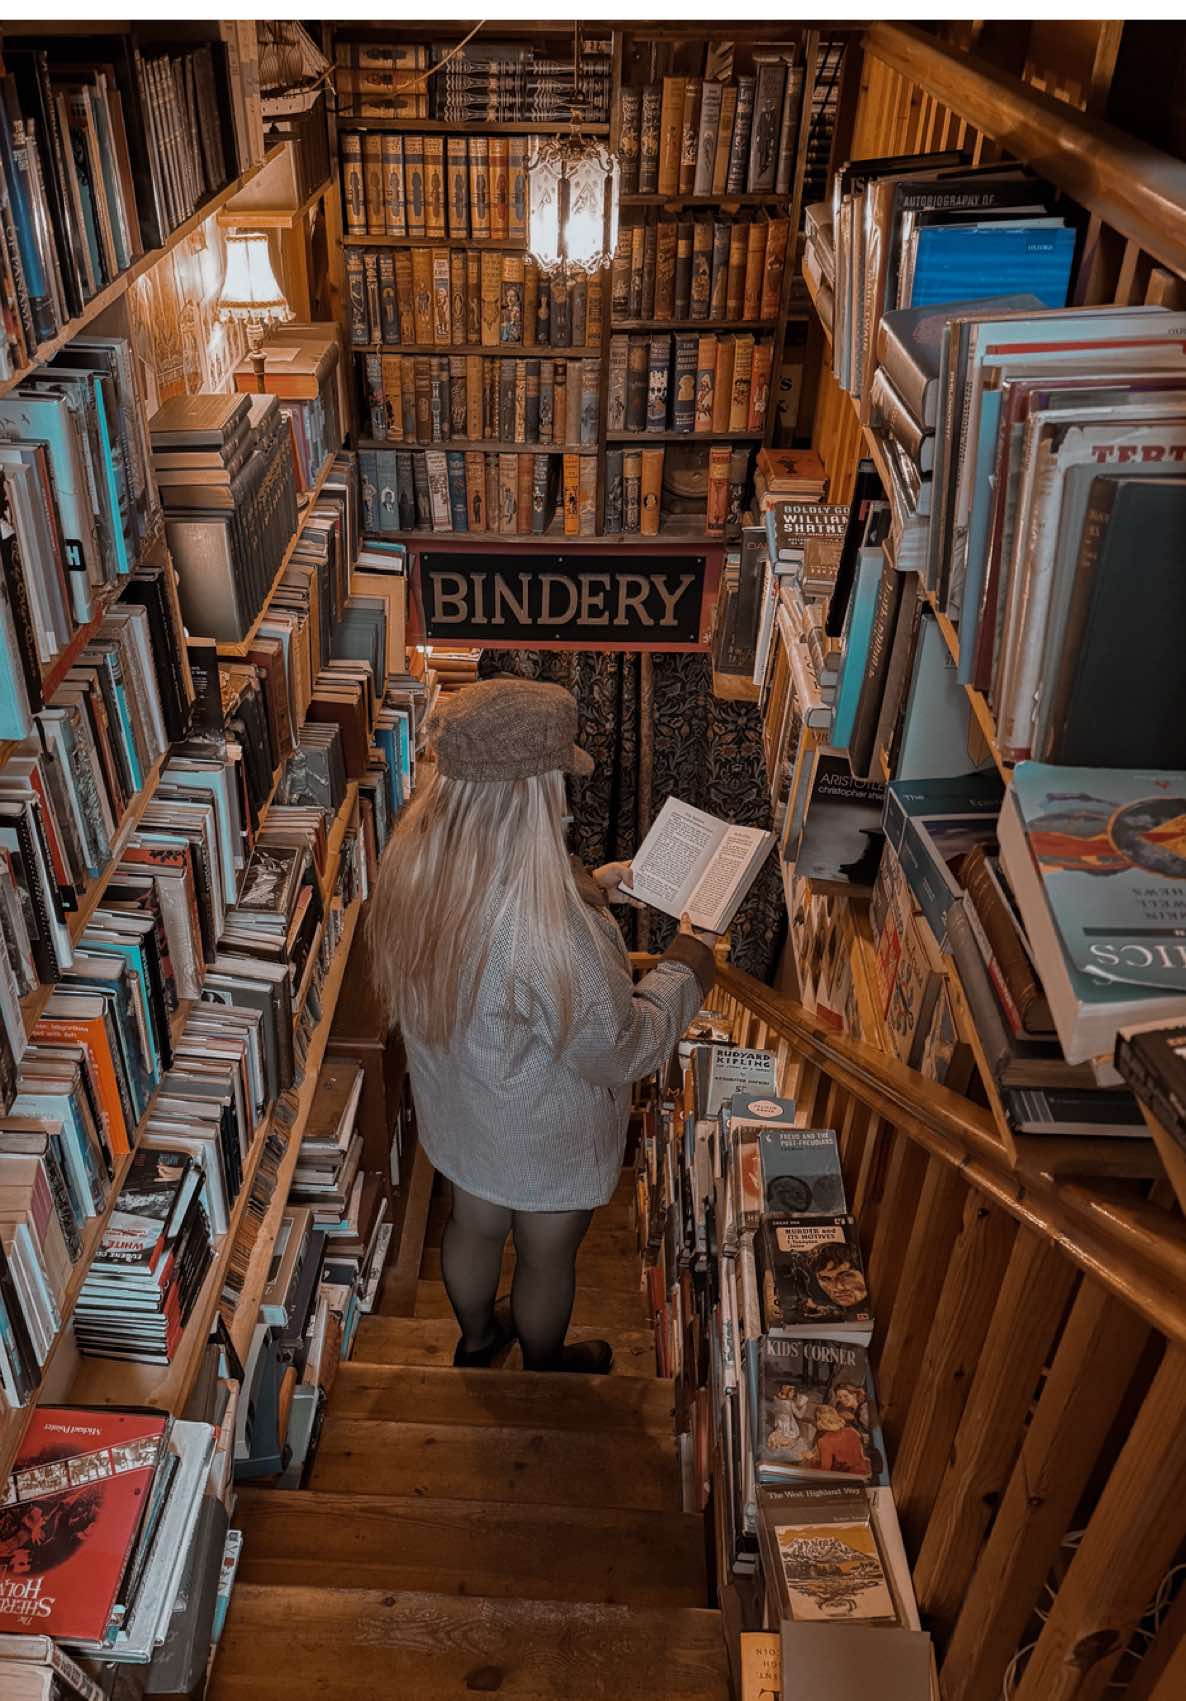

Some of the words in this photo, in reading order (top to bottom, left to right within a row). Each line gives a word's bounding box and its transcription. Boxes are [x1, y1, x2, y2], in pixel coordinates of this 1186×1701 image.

[903, 195, 979, 208] AUTOBIOGRAPHY
[982, 195, 996, 206] OF
[783, 505, 830, 514] BOLDLY
[783, 523, 845, 533] SHATNE
[428, 570, 696, 627] BINDERY
[817, 786, 866, 799] christopher
[716, 1050, 771, 1061] RUDYARD
[716, 1057, 771, 1068] KIPLING
[804, 1344, 856, 1367] CORNER
[767, 1491, 783, 1499] The
[784, 1490, 803, 1498] West
[806, 1488, 842, 1498] Highland
[843, 1487, 860, 1495] Way
[16, 1616, 33, 1626] The
